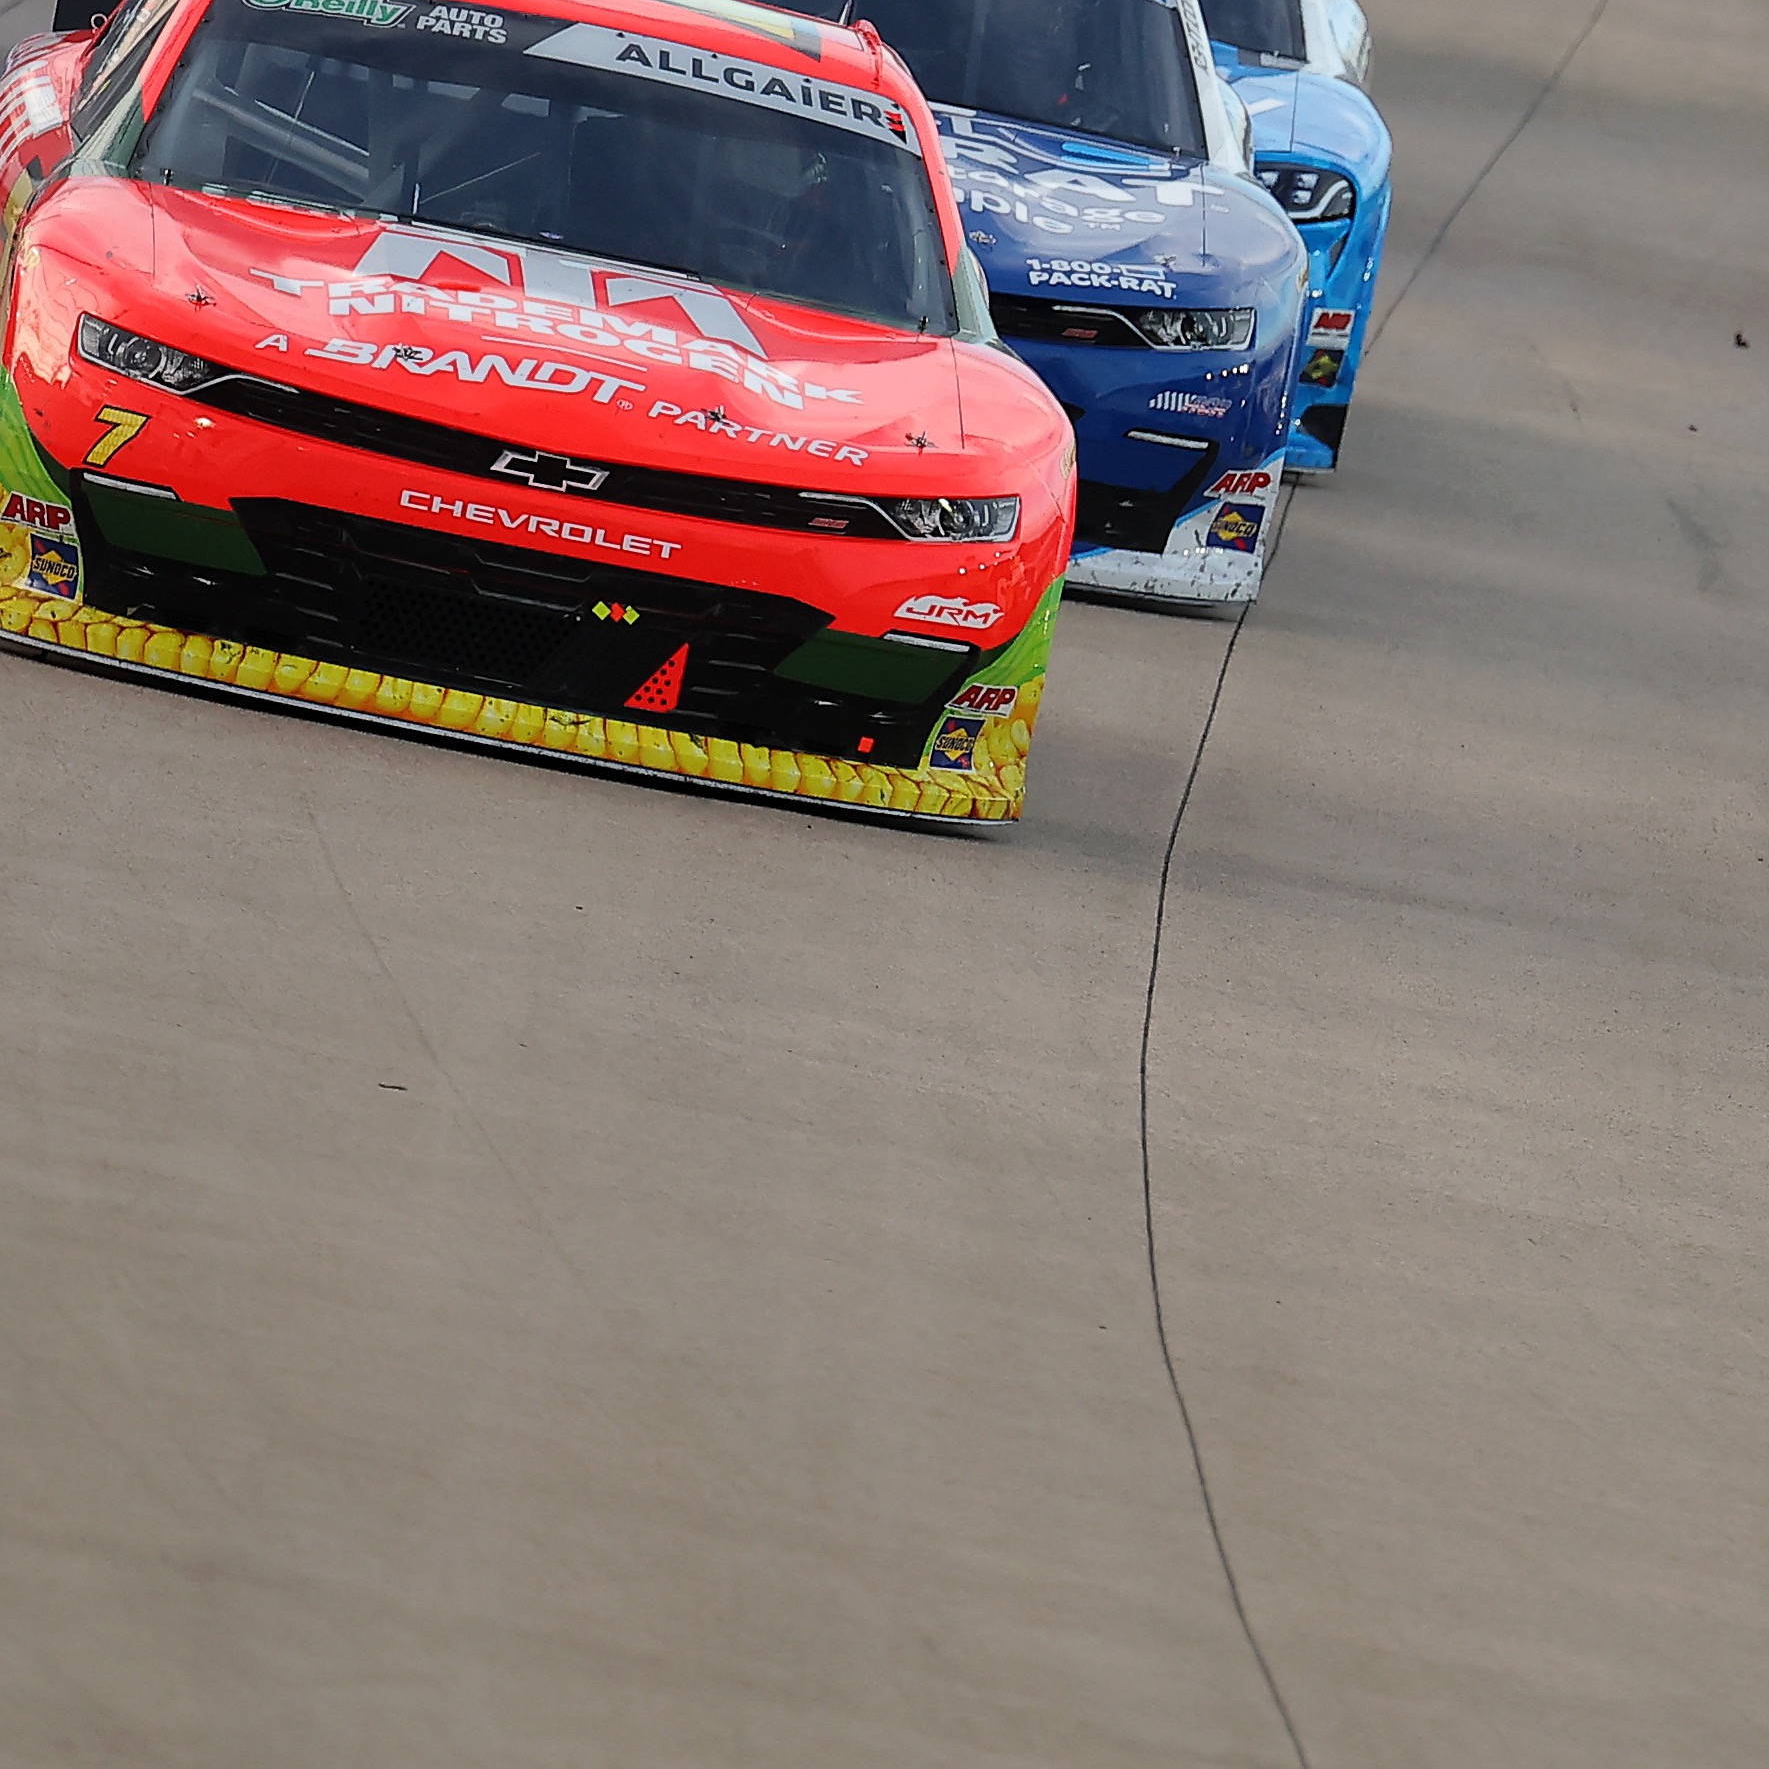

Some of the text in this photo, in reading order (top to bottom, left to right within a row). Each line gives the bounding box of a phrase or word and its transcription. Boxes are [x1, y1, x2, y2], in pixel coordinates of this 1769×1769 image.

[416, 16, 509, 44] PARTS
[428, 5, 504, 28] AUTO
[615, 43, 887, 128] ALLGAIER
[1028, 270, 1177, 300] PACK-RAT
[249, 268, 867, 406] TRADEMARK
[328, 294, 806, 412] NITROGEN
[254, 334, 872, 467] A BRANDT PARTNER
[83, 404, 152, 468] 7
[1210, 471, 1273, 494] ARP
[3, 494, 72, 531] ARP
[399, 489, 683, 560] CHEVROLET
[32, 556, 78, 582] SUNOCO
[905, 604, 990, 626] JRM
[953, 684, 1018, 711] ARP
[935, 732, 976, 753] SUNOCO
